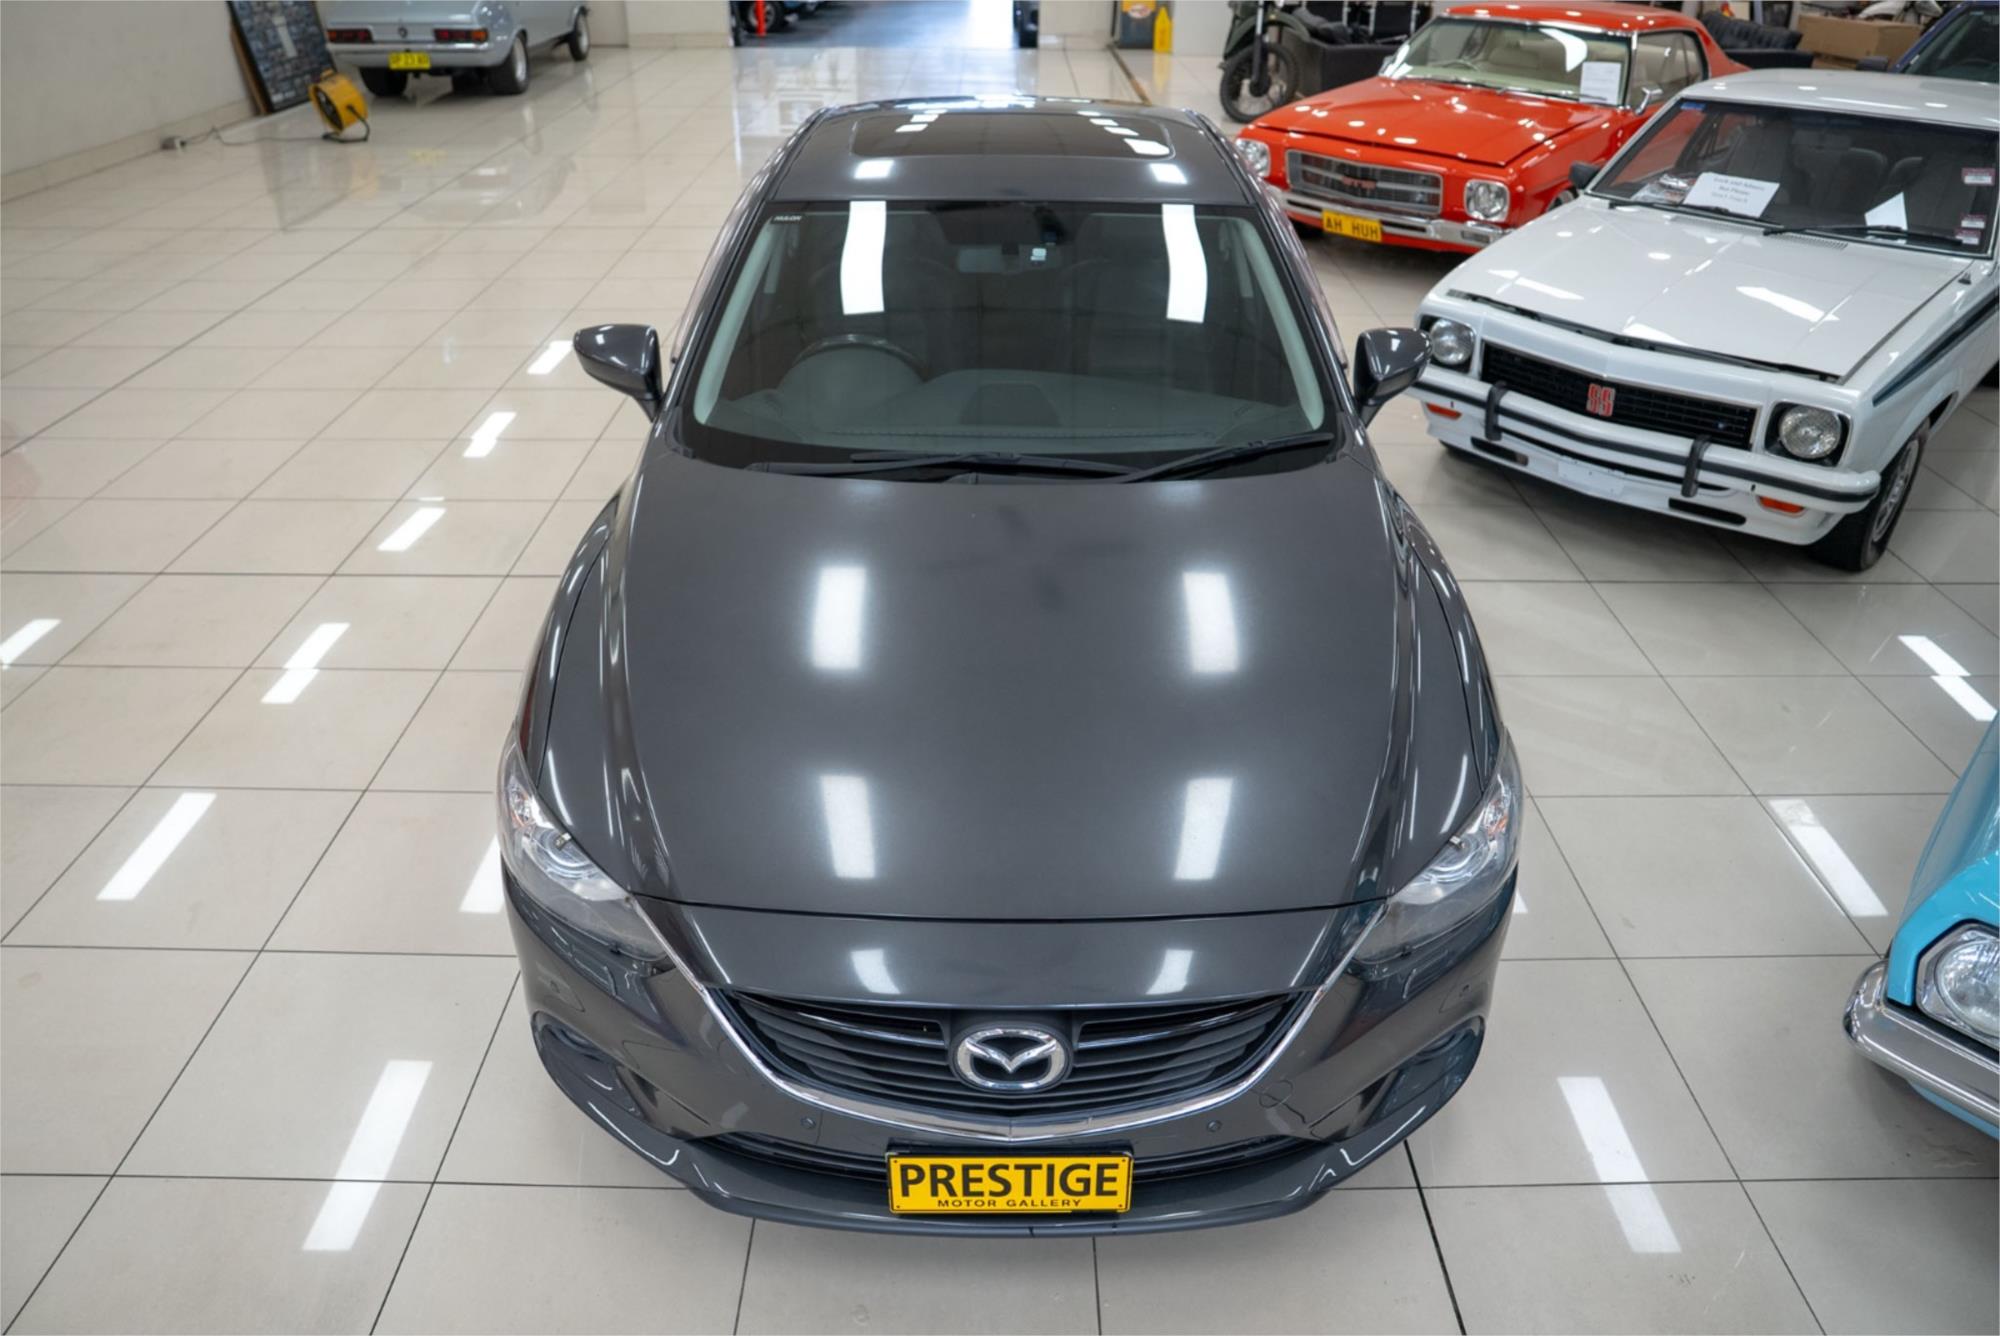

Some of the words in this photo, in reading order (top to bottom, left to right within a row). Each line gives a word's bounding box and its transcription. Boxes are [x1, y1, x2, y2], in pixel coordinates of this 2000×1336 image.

[1326, 216, 1342, 232] AH
[1351, 220, 1378, 240] HUH
[900, 1163, 1119, 1198] PRESTIGE
[937, 1199, 997, 1208] MOTOR
[1006, 1199, 1082, 1208] GALLERY
